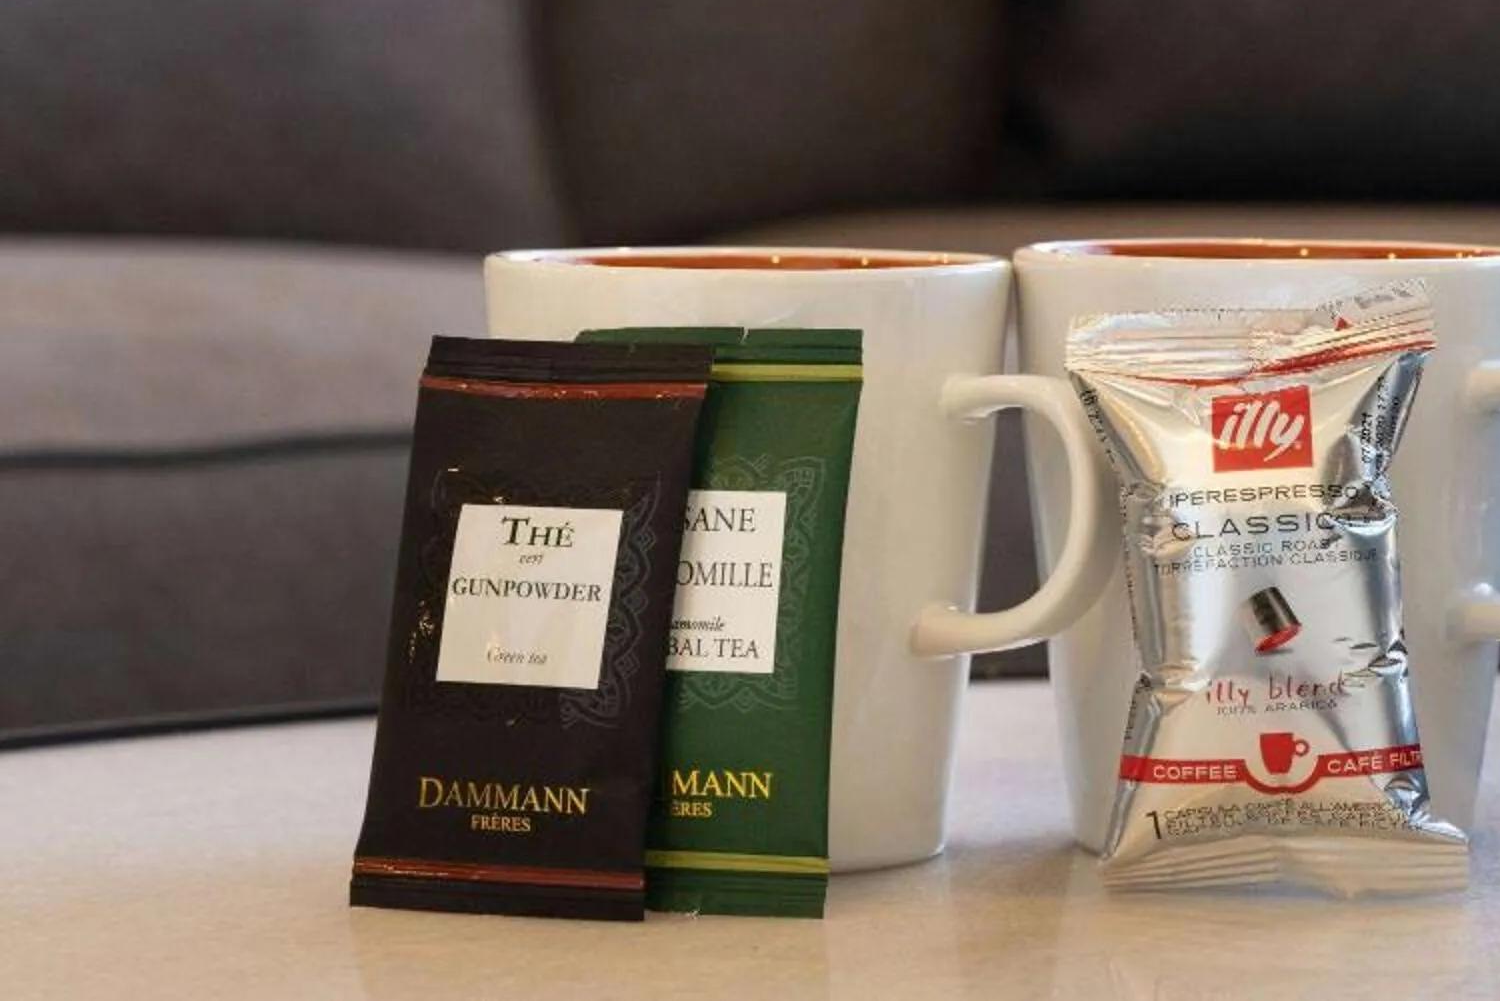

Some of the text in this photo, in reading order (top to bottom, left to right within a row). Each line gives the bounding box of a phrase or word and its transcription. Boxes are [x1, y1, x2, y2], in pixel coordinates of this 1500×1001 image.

[1217, 399, 1305, 462] illy
[1171, 512, 1346, 541] CLASSIC
[1193, 542, 1273, 561] CLASSIC
[451, 576, 602, 602] GUNPOWDER
[713, 638, 760, 659] TEA
[1205, 671, 1347, 706] illy blend
[1153, 764, 1237, 781] COFFEE
[1327, 754, 1384, 775] CAFÉ
[419, 775, 591, 816] DAMMANN
